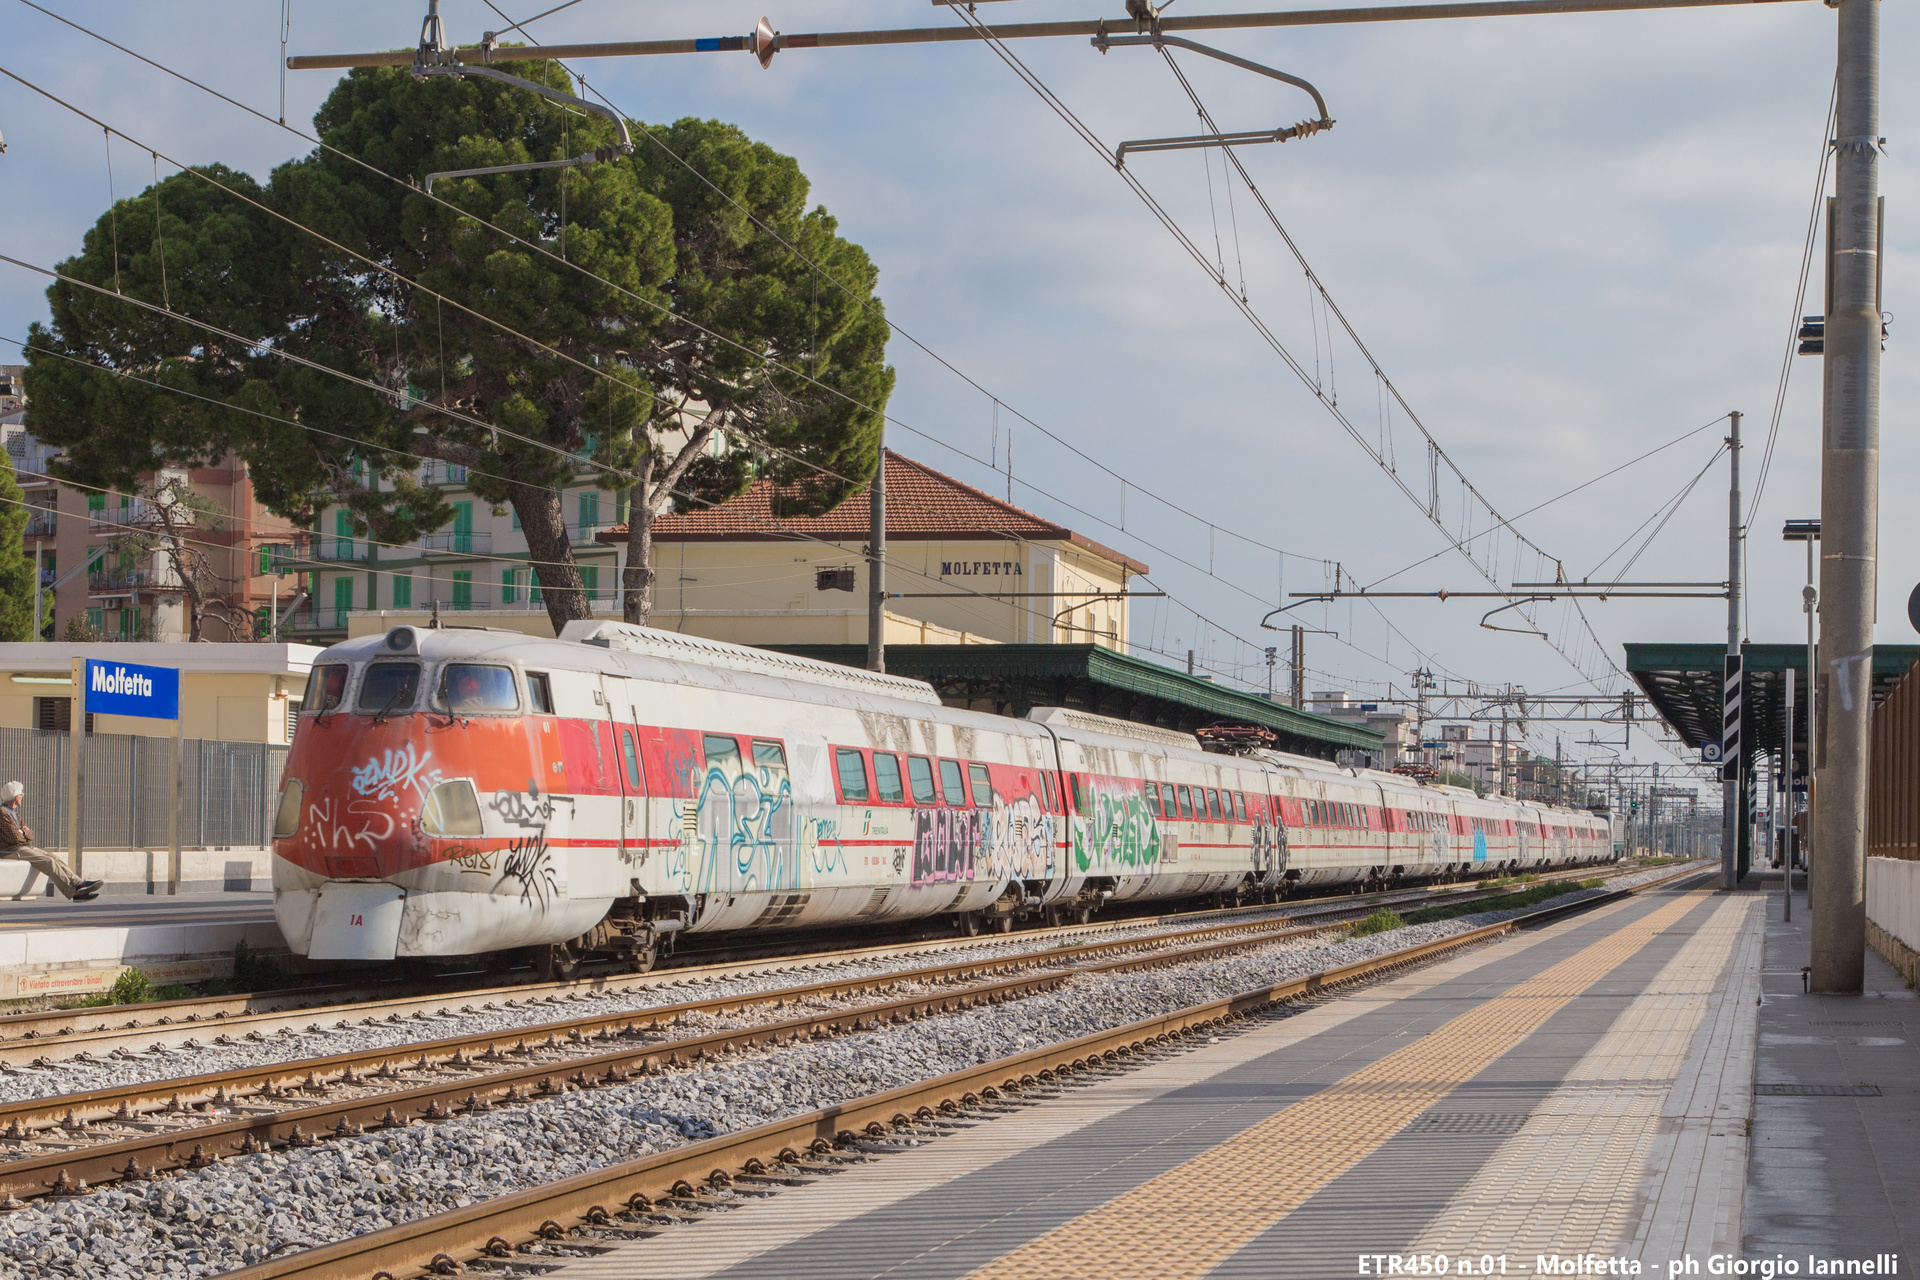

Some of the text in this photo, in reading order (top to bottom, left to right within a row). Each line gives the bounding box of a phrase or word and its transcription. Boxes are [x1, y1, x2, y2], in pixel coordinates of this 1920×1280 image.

[941, 562, 1022, 575] MOLFETTA
[92, 665, 152, 697] Molfetta
[1708, 748, 1716, 756] 3
[350, 914, 363, 926] 1A
[29, 980, 49, 989] Vietato
[51, 978, 83, 987] attraversare
[87, 975, 102, 984] binari
